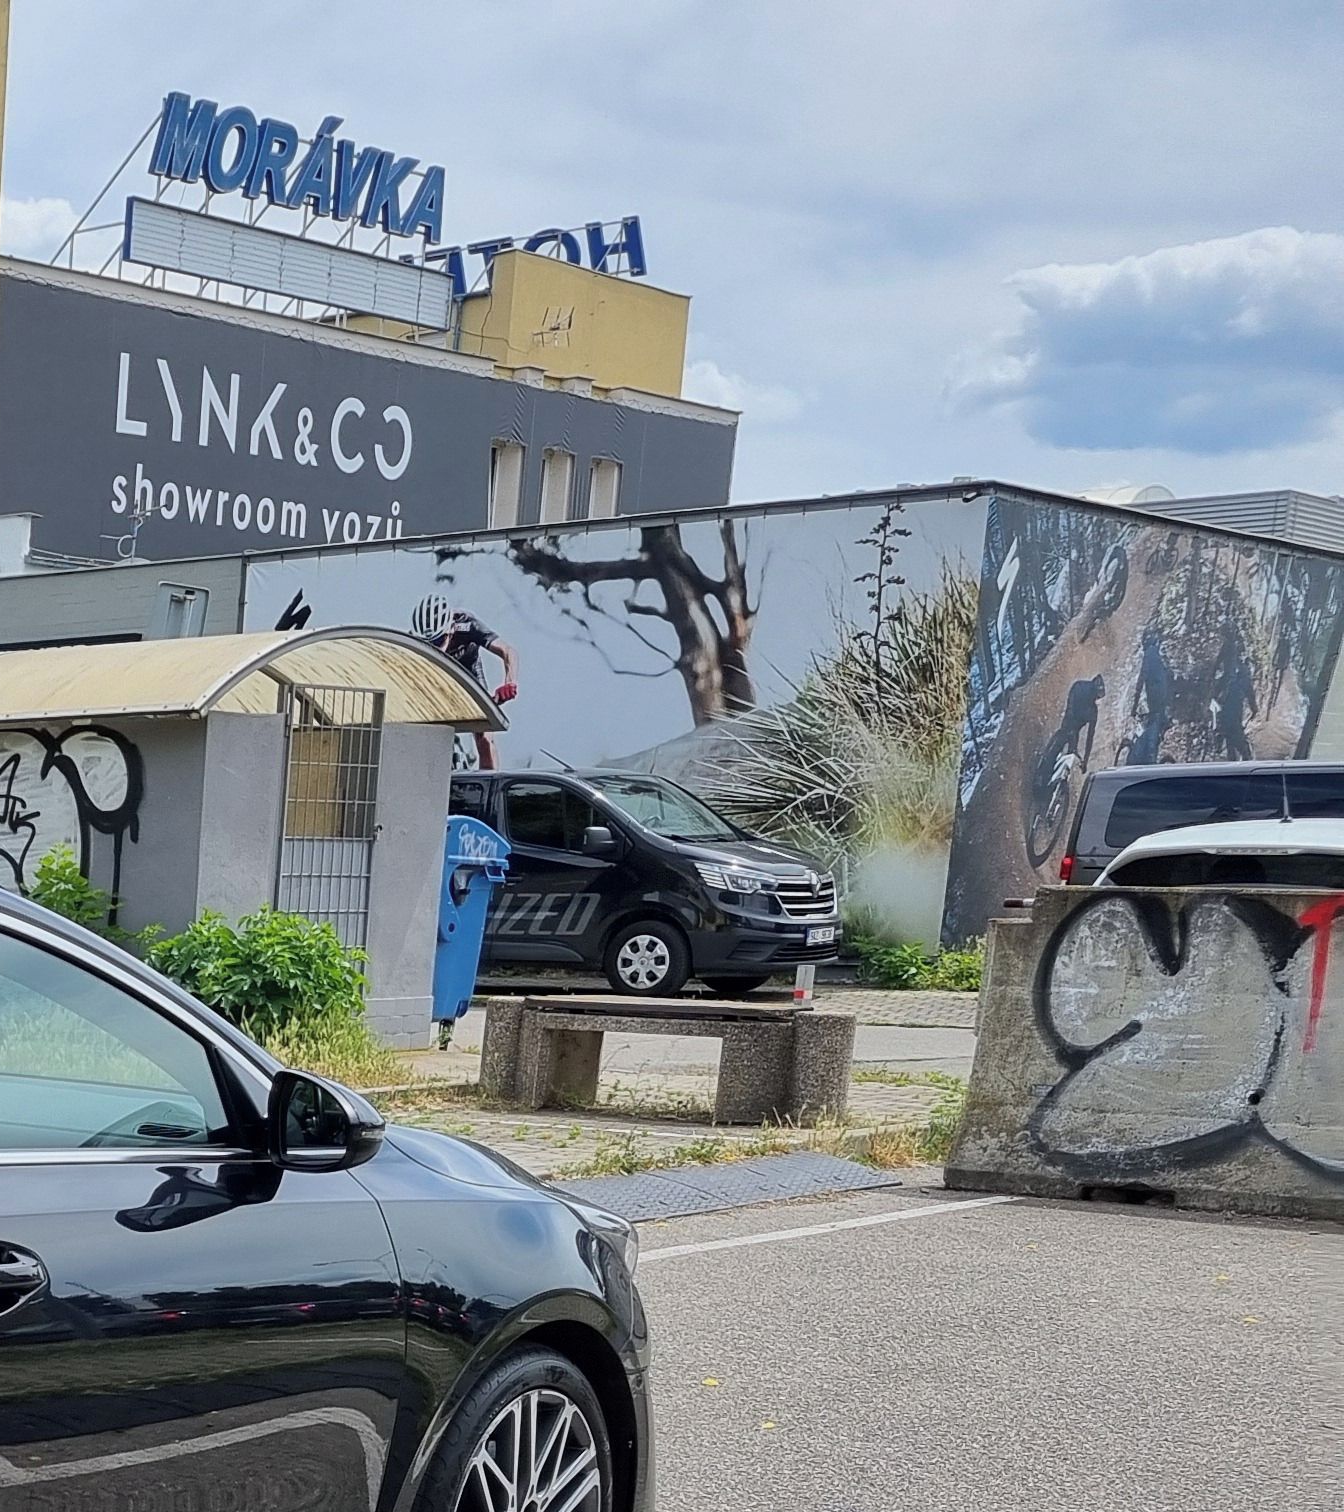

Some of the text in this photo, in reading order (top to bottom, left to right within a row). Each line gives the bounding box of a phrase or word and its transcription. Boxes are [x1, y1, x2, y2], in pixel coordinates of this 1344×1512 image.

[148, 91, 447, 245] MORÁVKA
[111, 462, 404, 542] showroom vozů
